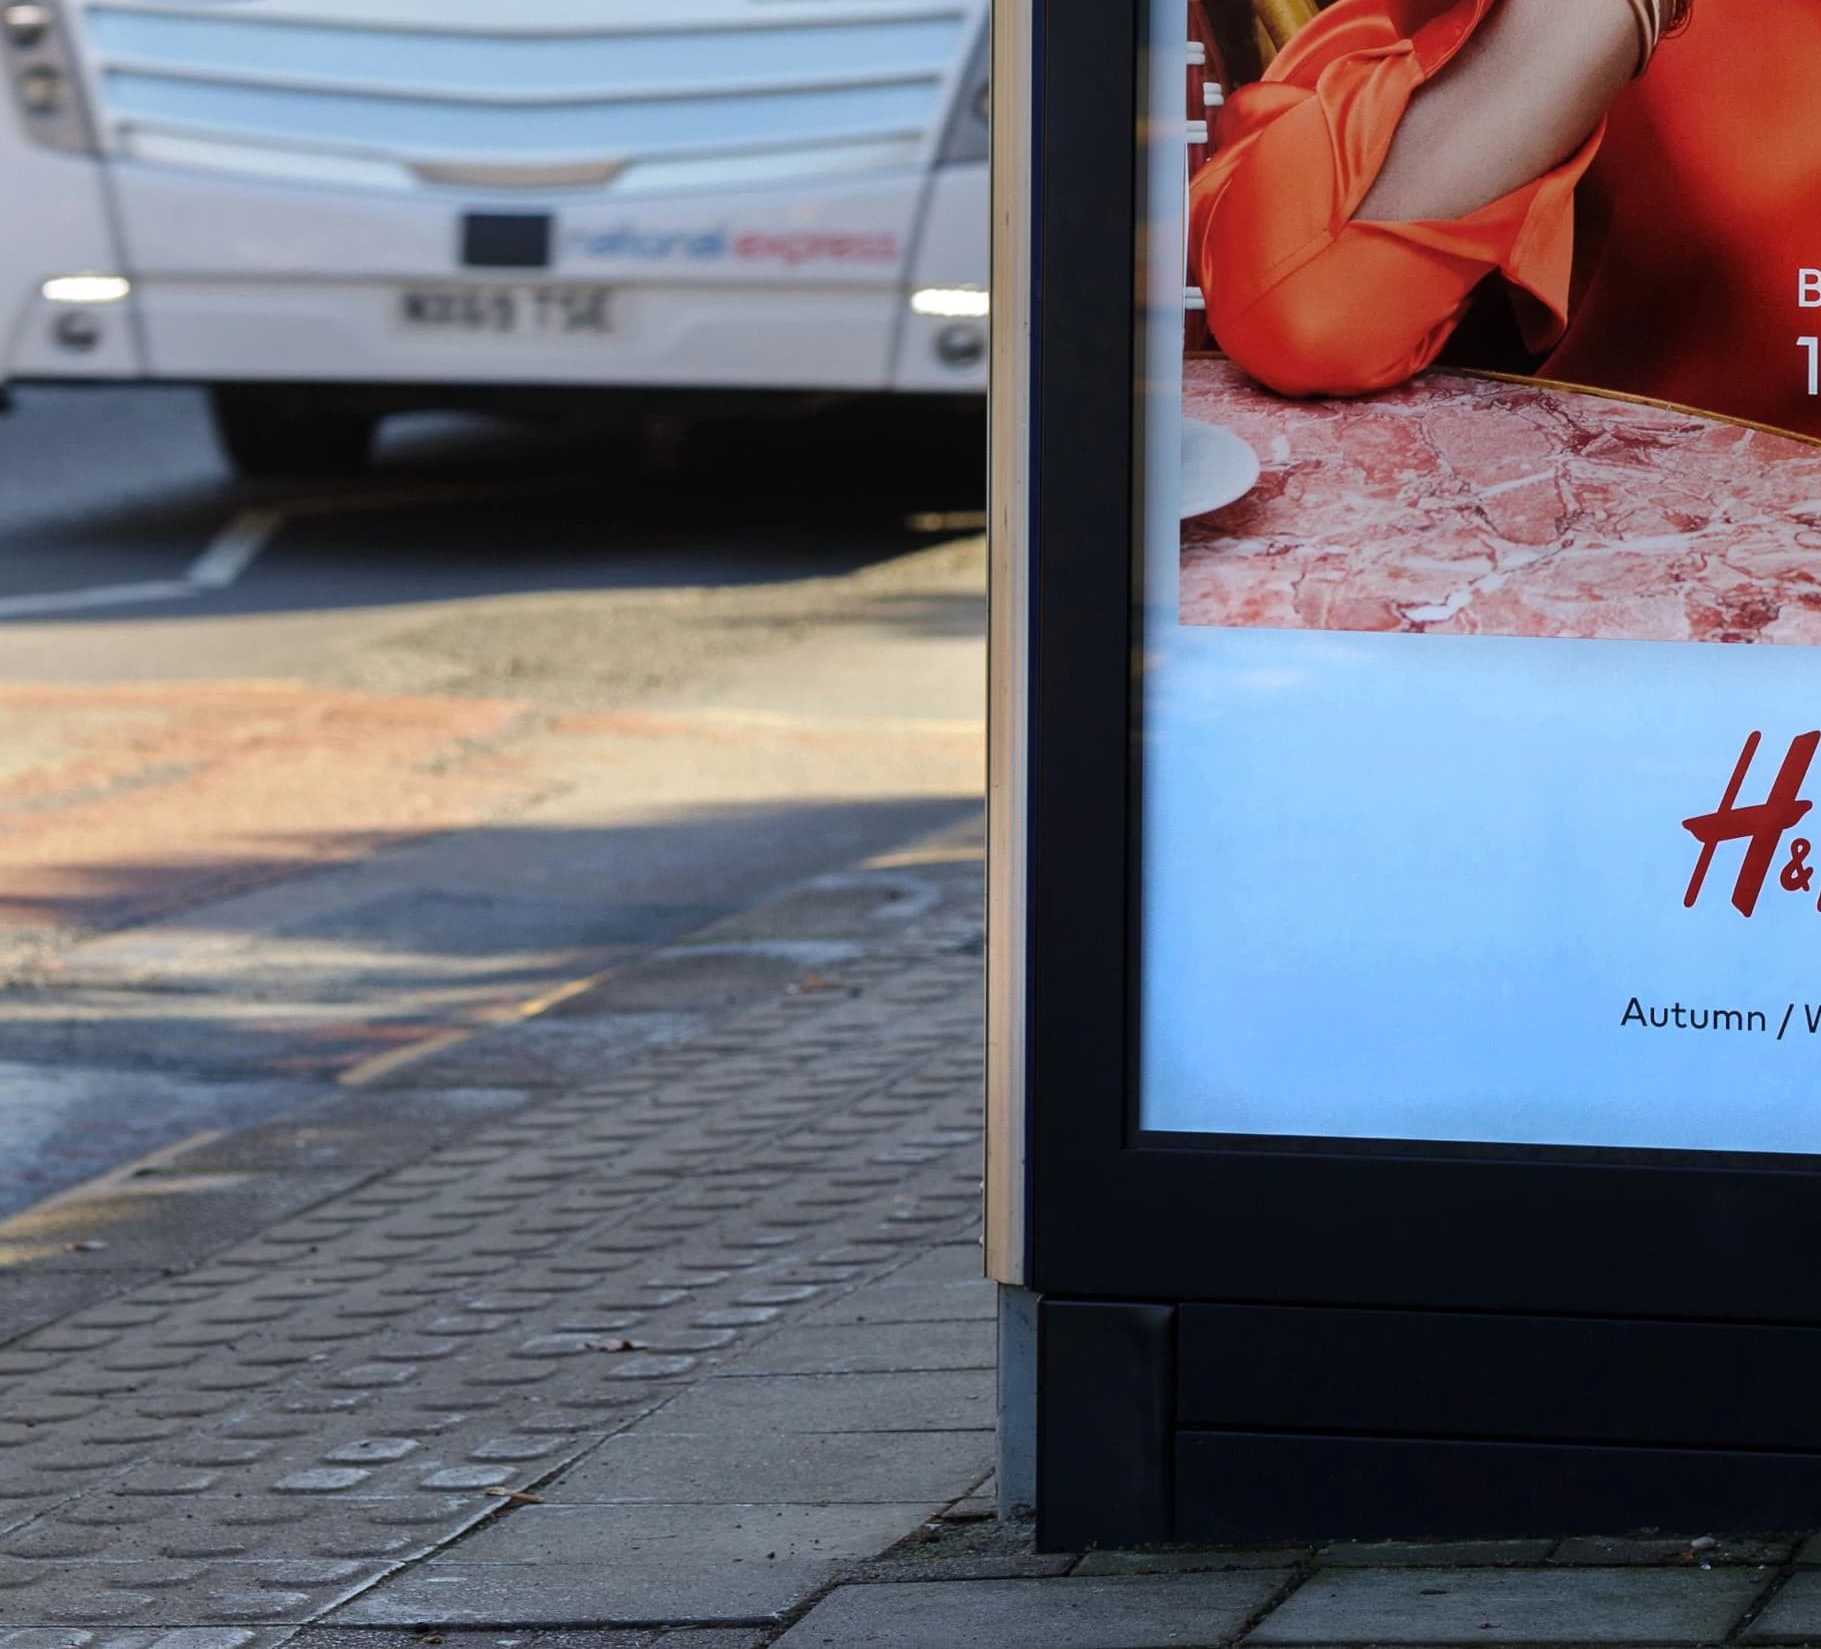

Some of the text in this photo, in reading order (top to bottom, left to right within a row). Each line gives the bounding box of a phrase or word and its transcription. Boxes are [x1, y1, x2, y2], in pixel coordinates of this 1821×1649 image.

[735, 230, 898, 267] express
[1620, 997, 1766, 1032] Autumn
[1776, 1003, 1795, 1041] /
